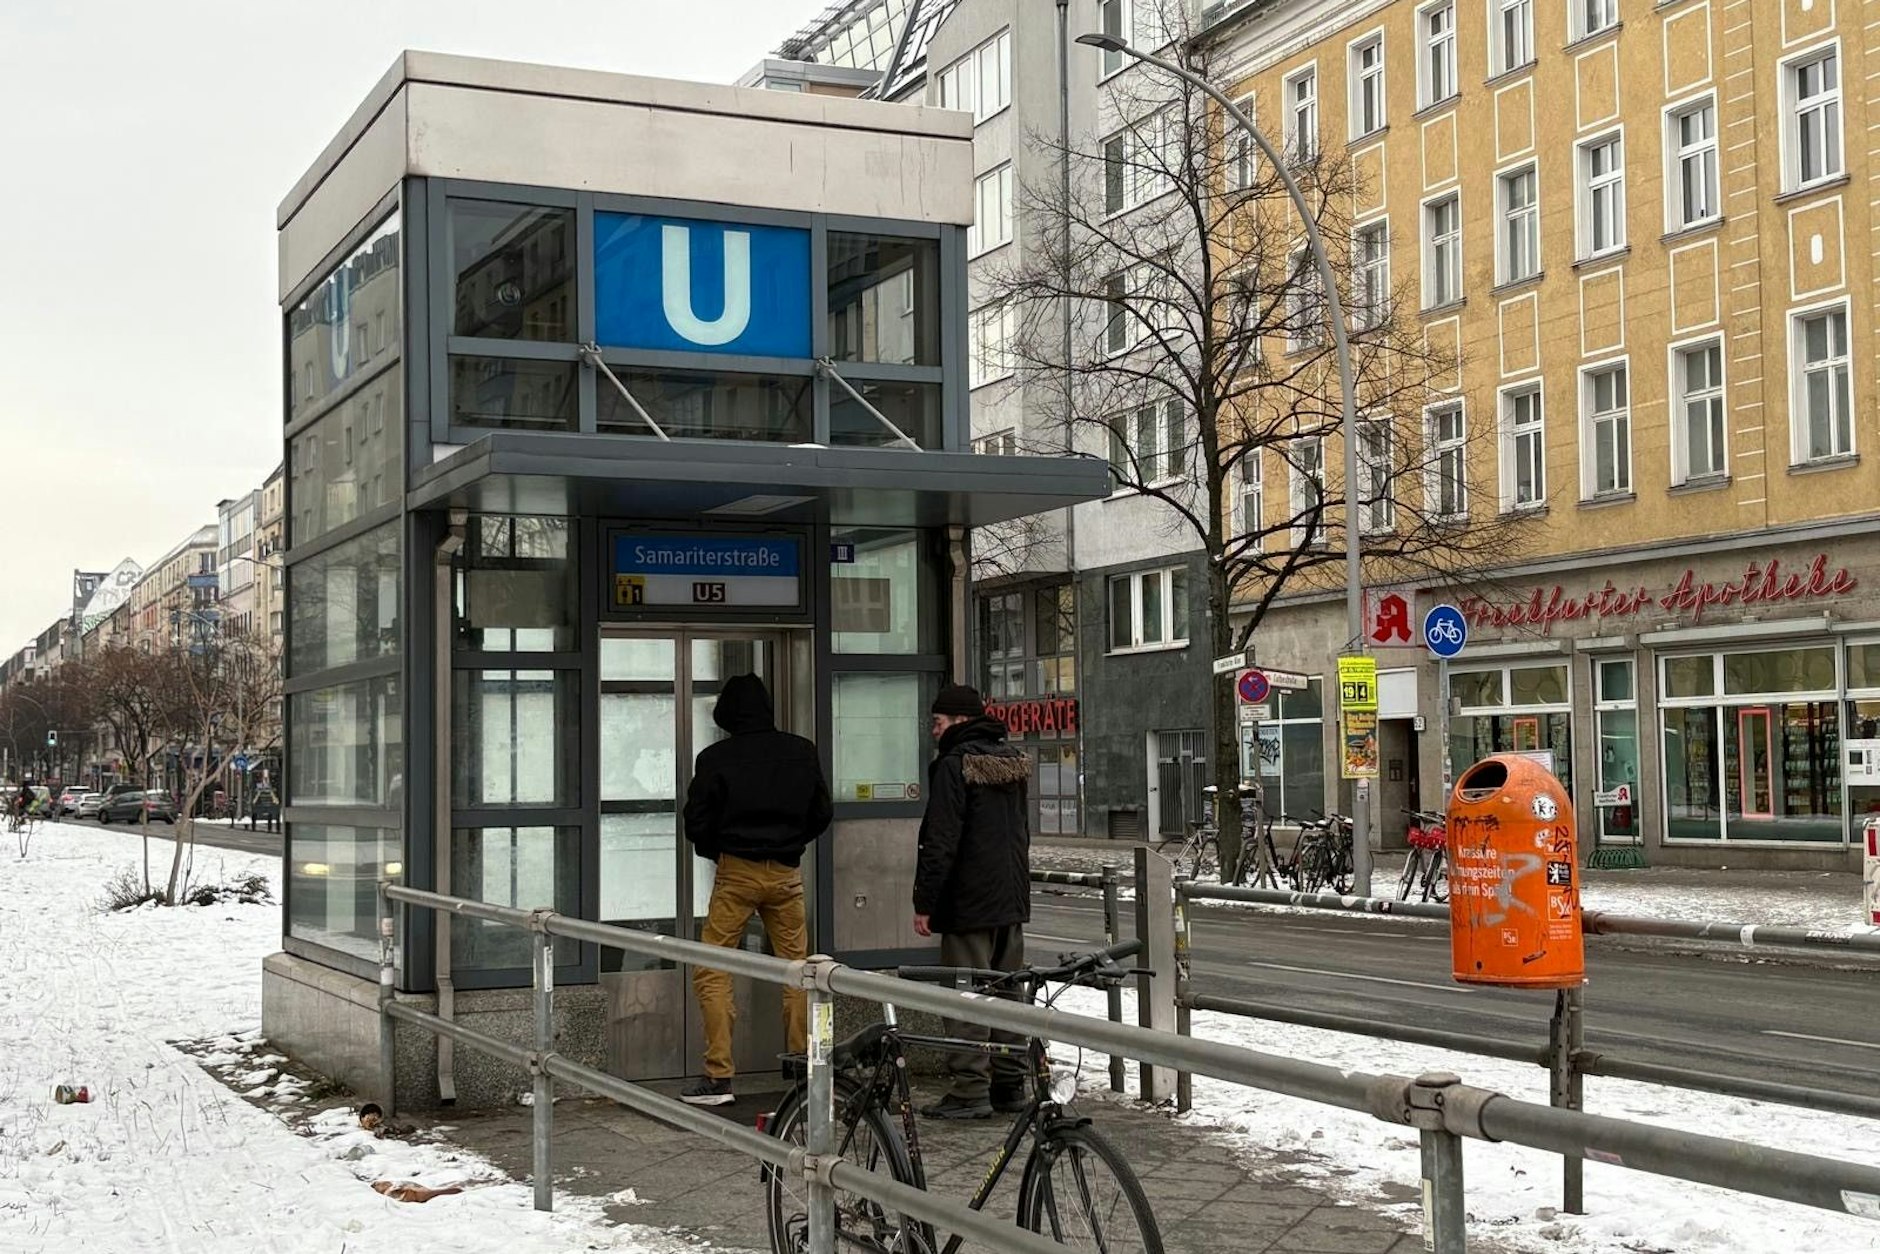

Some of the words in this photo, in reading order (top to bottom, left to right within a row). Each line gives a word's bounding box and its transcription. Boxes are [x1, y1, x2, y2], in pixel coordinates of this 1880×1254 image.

[662, 225, 750, 345] U
[634, 545, 780, 567] Samariterstraße
[695, 584, 723, 601] U5
[1661, 554, 1856, 620] Apotheke
